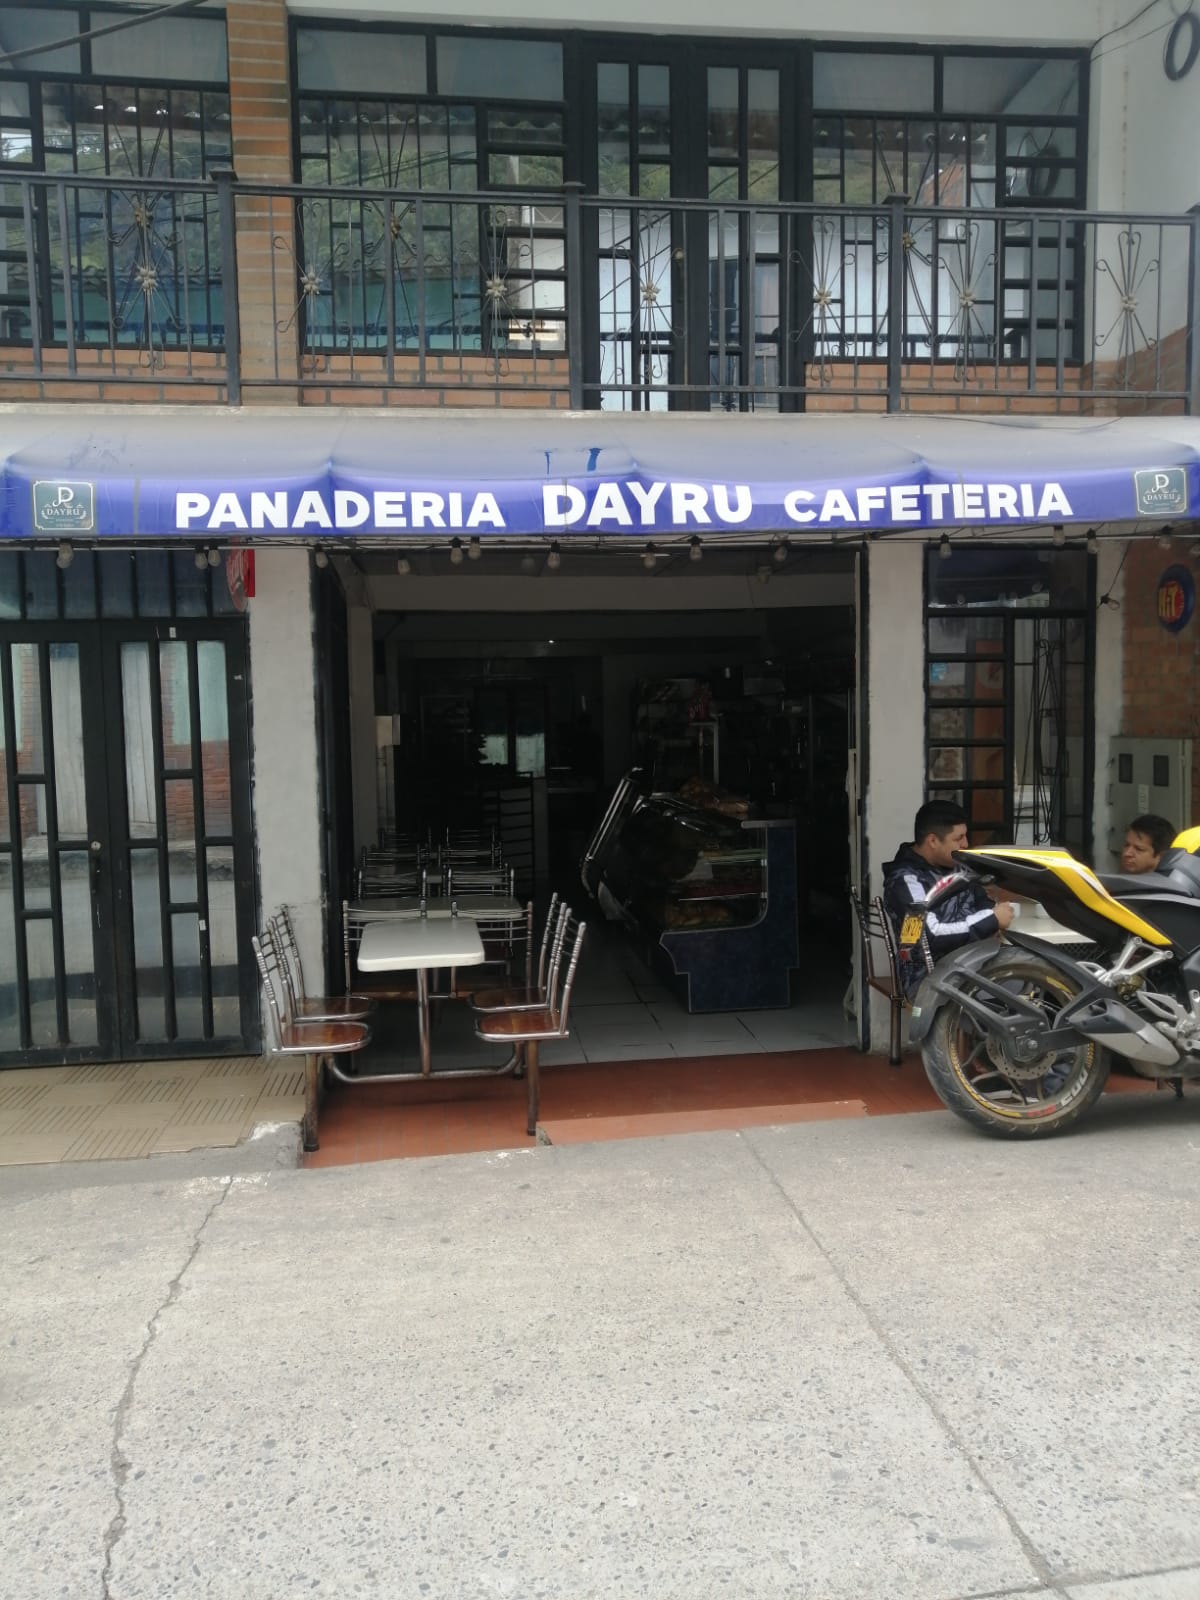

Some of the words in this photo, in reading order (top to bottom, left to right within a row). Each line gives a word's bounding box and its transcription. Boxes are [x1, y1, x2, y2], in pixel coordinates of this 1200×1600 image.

[46, 508, 81, 516] DAYRU
[175, 490, 506, 528] PANADERIA
[542, 481, 753, 526] DAYRU
[784, 483, 1074, 522] CAFETERIA
